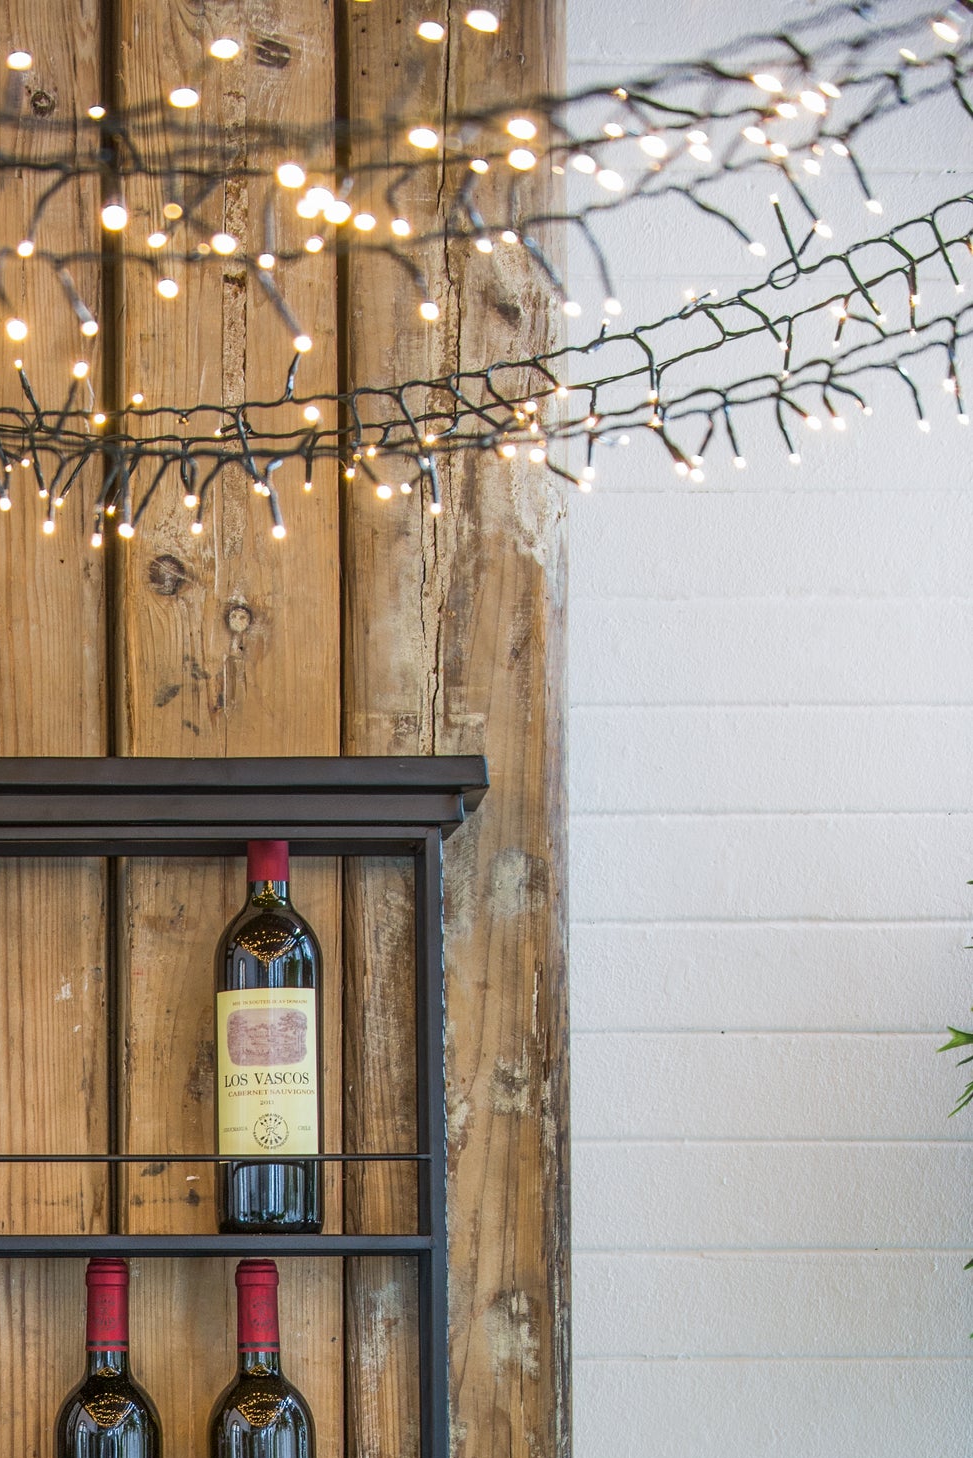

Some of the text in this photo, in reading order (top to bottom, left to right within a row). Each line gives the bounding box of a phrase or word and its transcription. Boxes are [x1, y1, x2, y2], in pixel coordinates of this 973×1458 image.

[224, 1072, 310, 1088] LOS VASCOS
[228, 1089, 268, 1098] CABERNET
